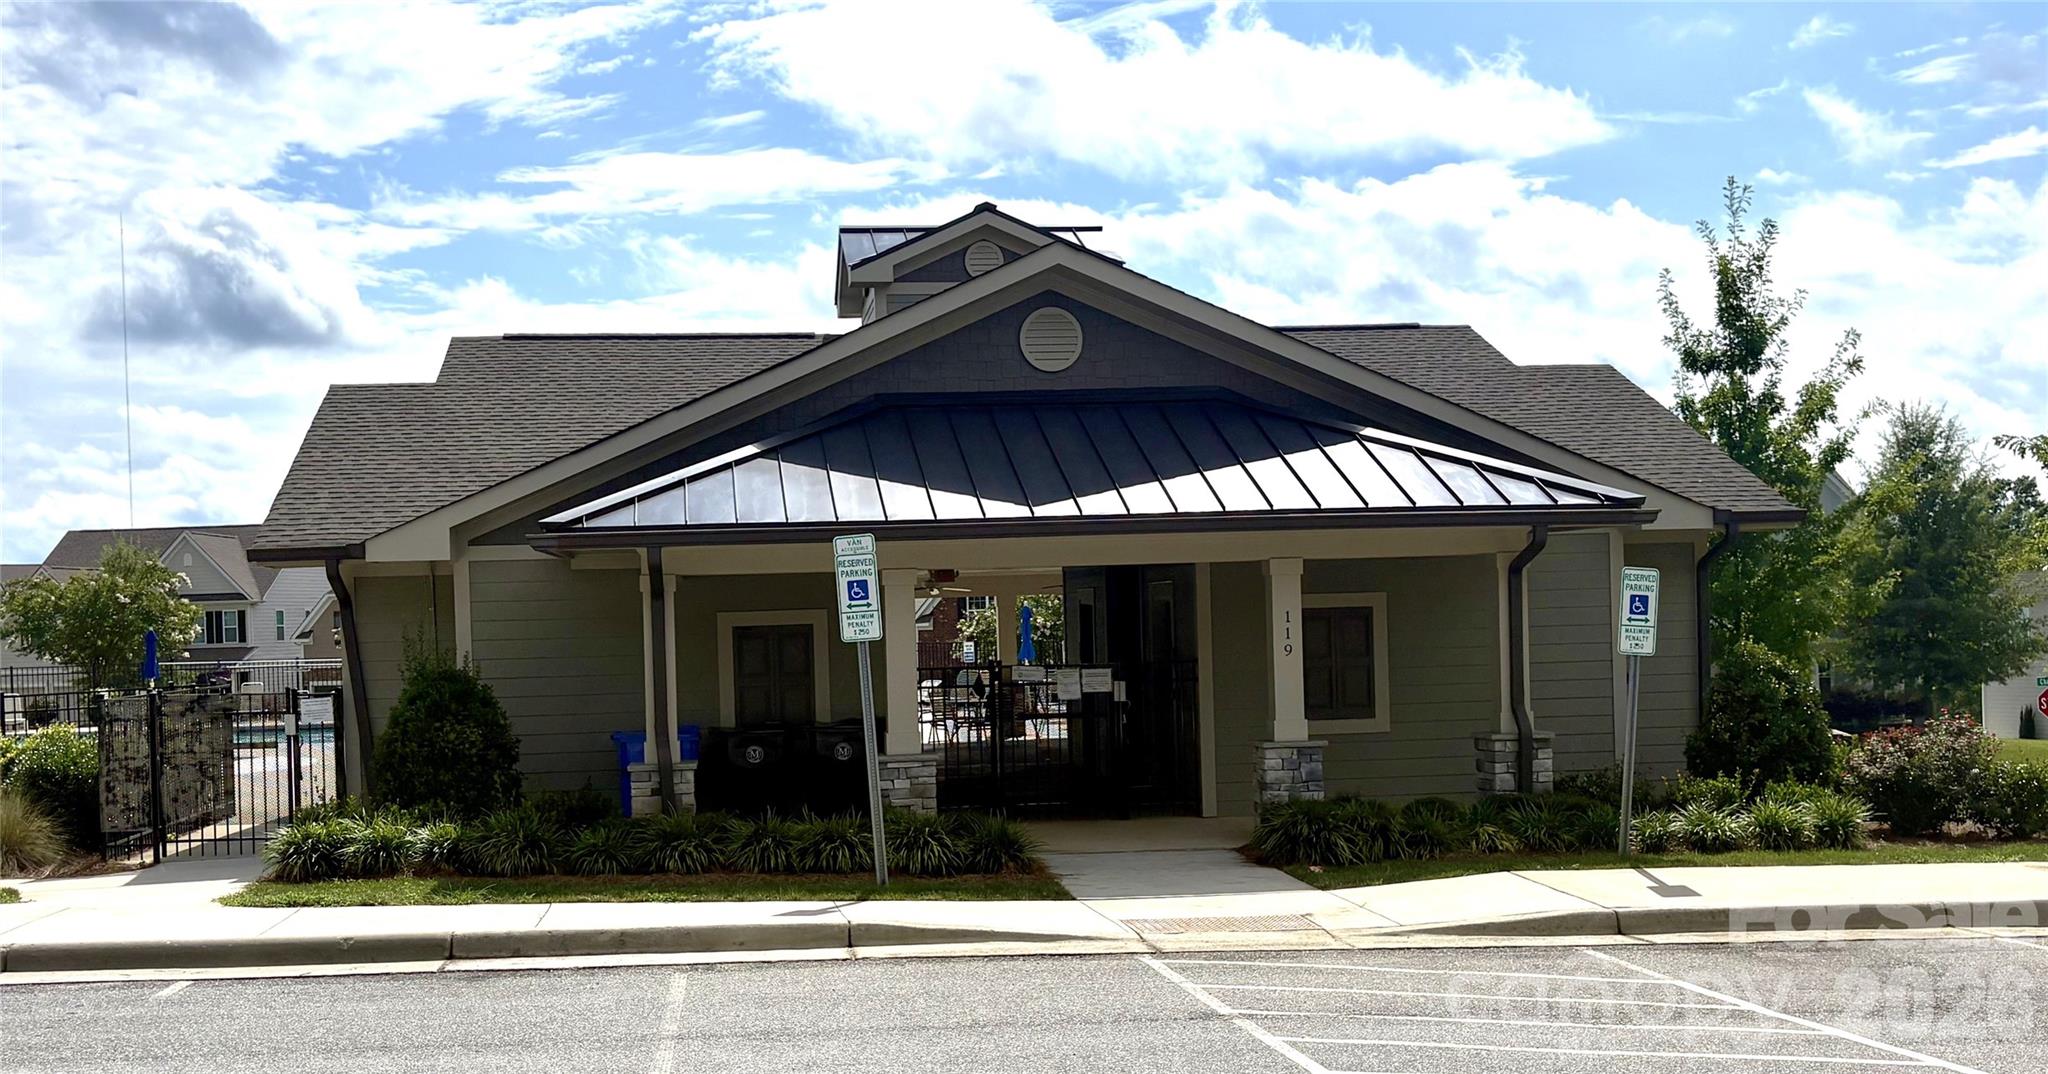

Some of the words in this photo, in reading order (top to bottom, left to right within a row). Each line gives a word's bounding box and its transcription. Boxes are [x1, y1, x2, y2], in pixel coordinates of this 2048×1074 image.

[847, 538, 862, 546] VAN
[838, 558, 873, 568] RESERVED
[841, 568, 873, 578] PARKING
[1624, 573, 1657, 582] RESERVED
[1625, 583, 1655, 592] PARKING
[846, 613, 874, 621] MAXIMUM
[848, 620, 874, 628] PENALTY
[1284, 610, 1293, 657] 119
[1624, 627, 1650, 635] MAXIMUM
